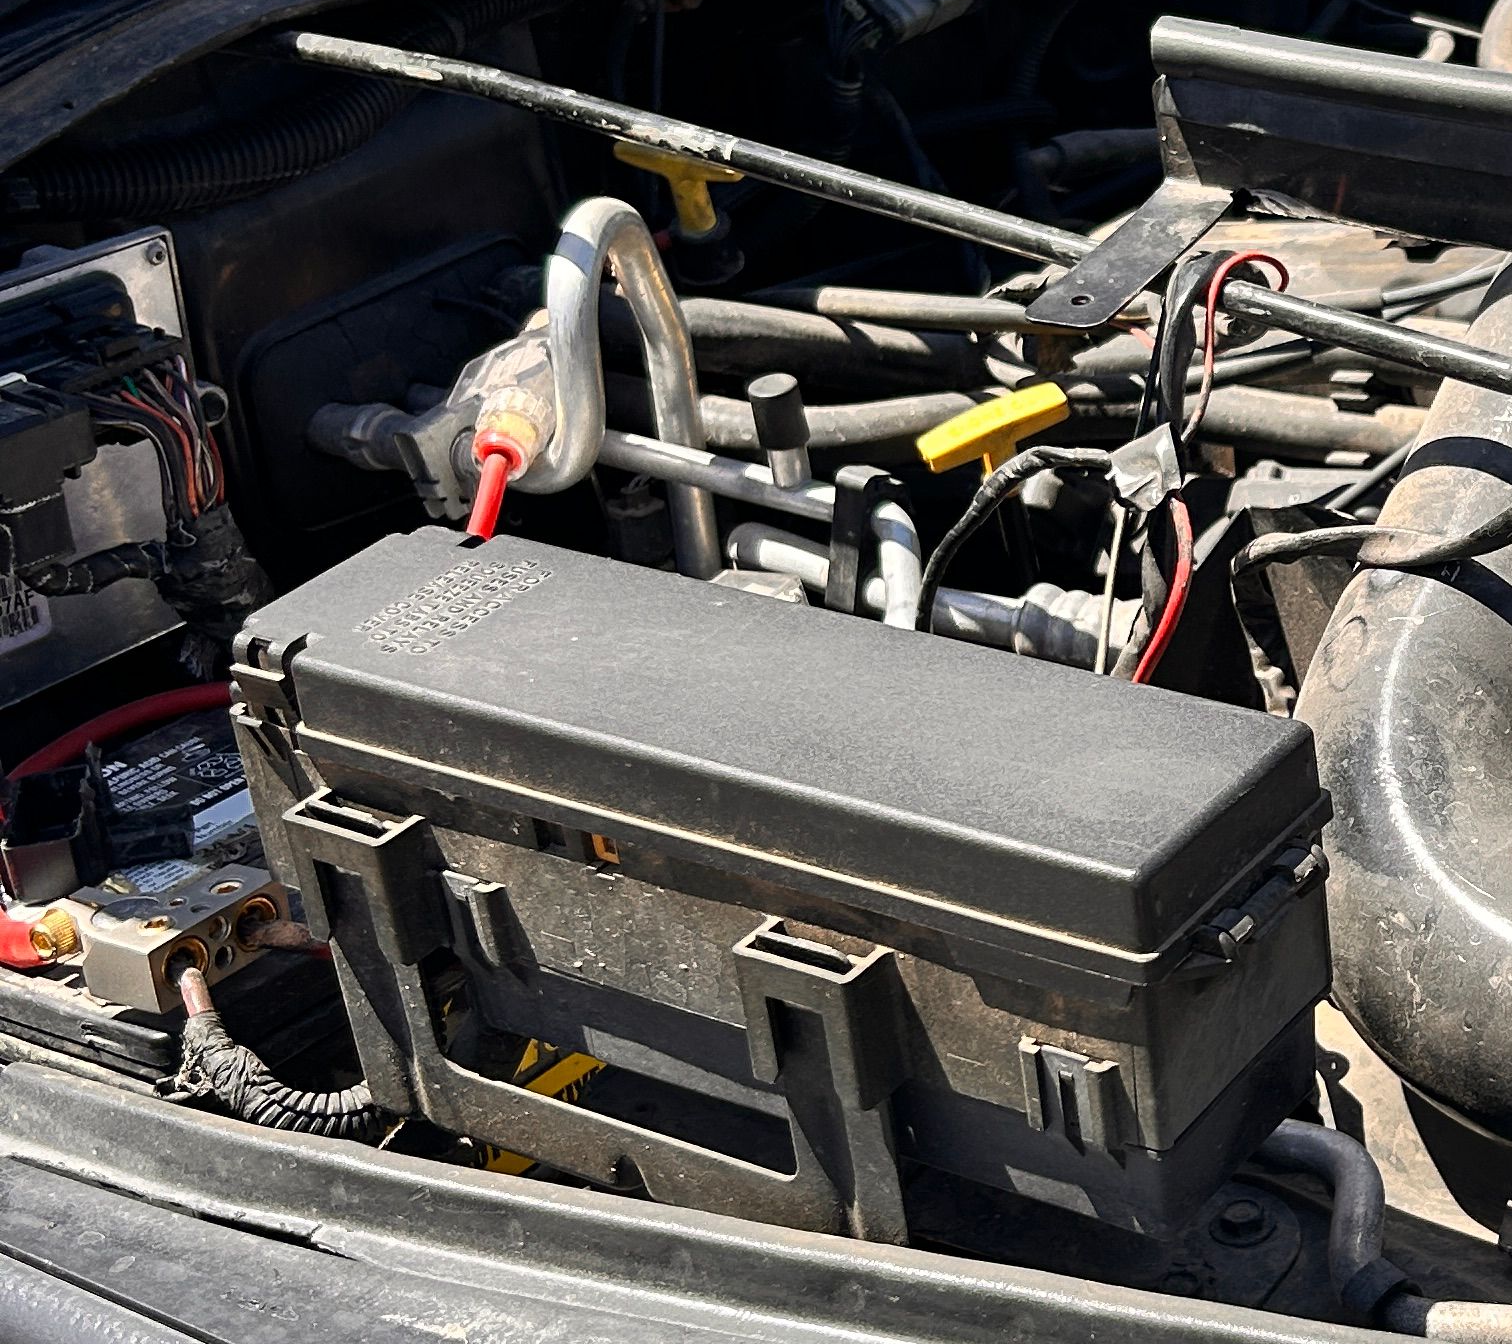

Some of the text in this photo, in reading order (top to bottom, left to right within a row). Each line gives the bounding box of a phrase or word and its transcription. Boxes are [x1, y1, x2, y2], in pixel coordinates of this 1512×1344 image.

[0, 587, 35, 616] 7AF
[353, 559, 481, 633] RELEASE COVER
[370, 561, 506, 642] SQUEEZE TABS TO
[380, 559, 538, 654] FUSES AND RELAYS
[409, 569, 552, 654] FOR ACCESS TO
